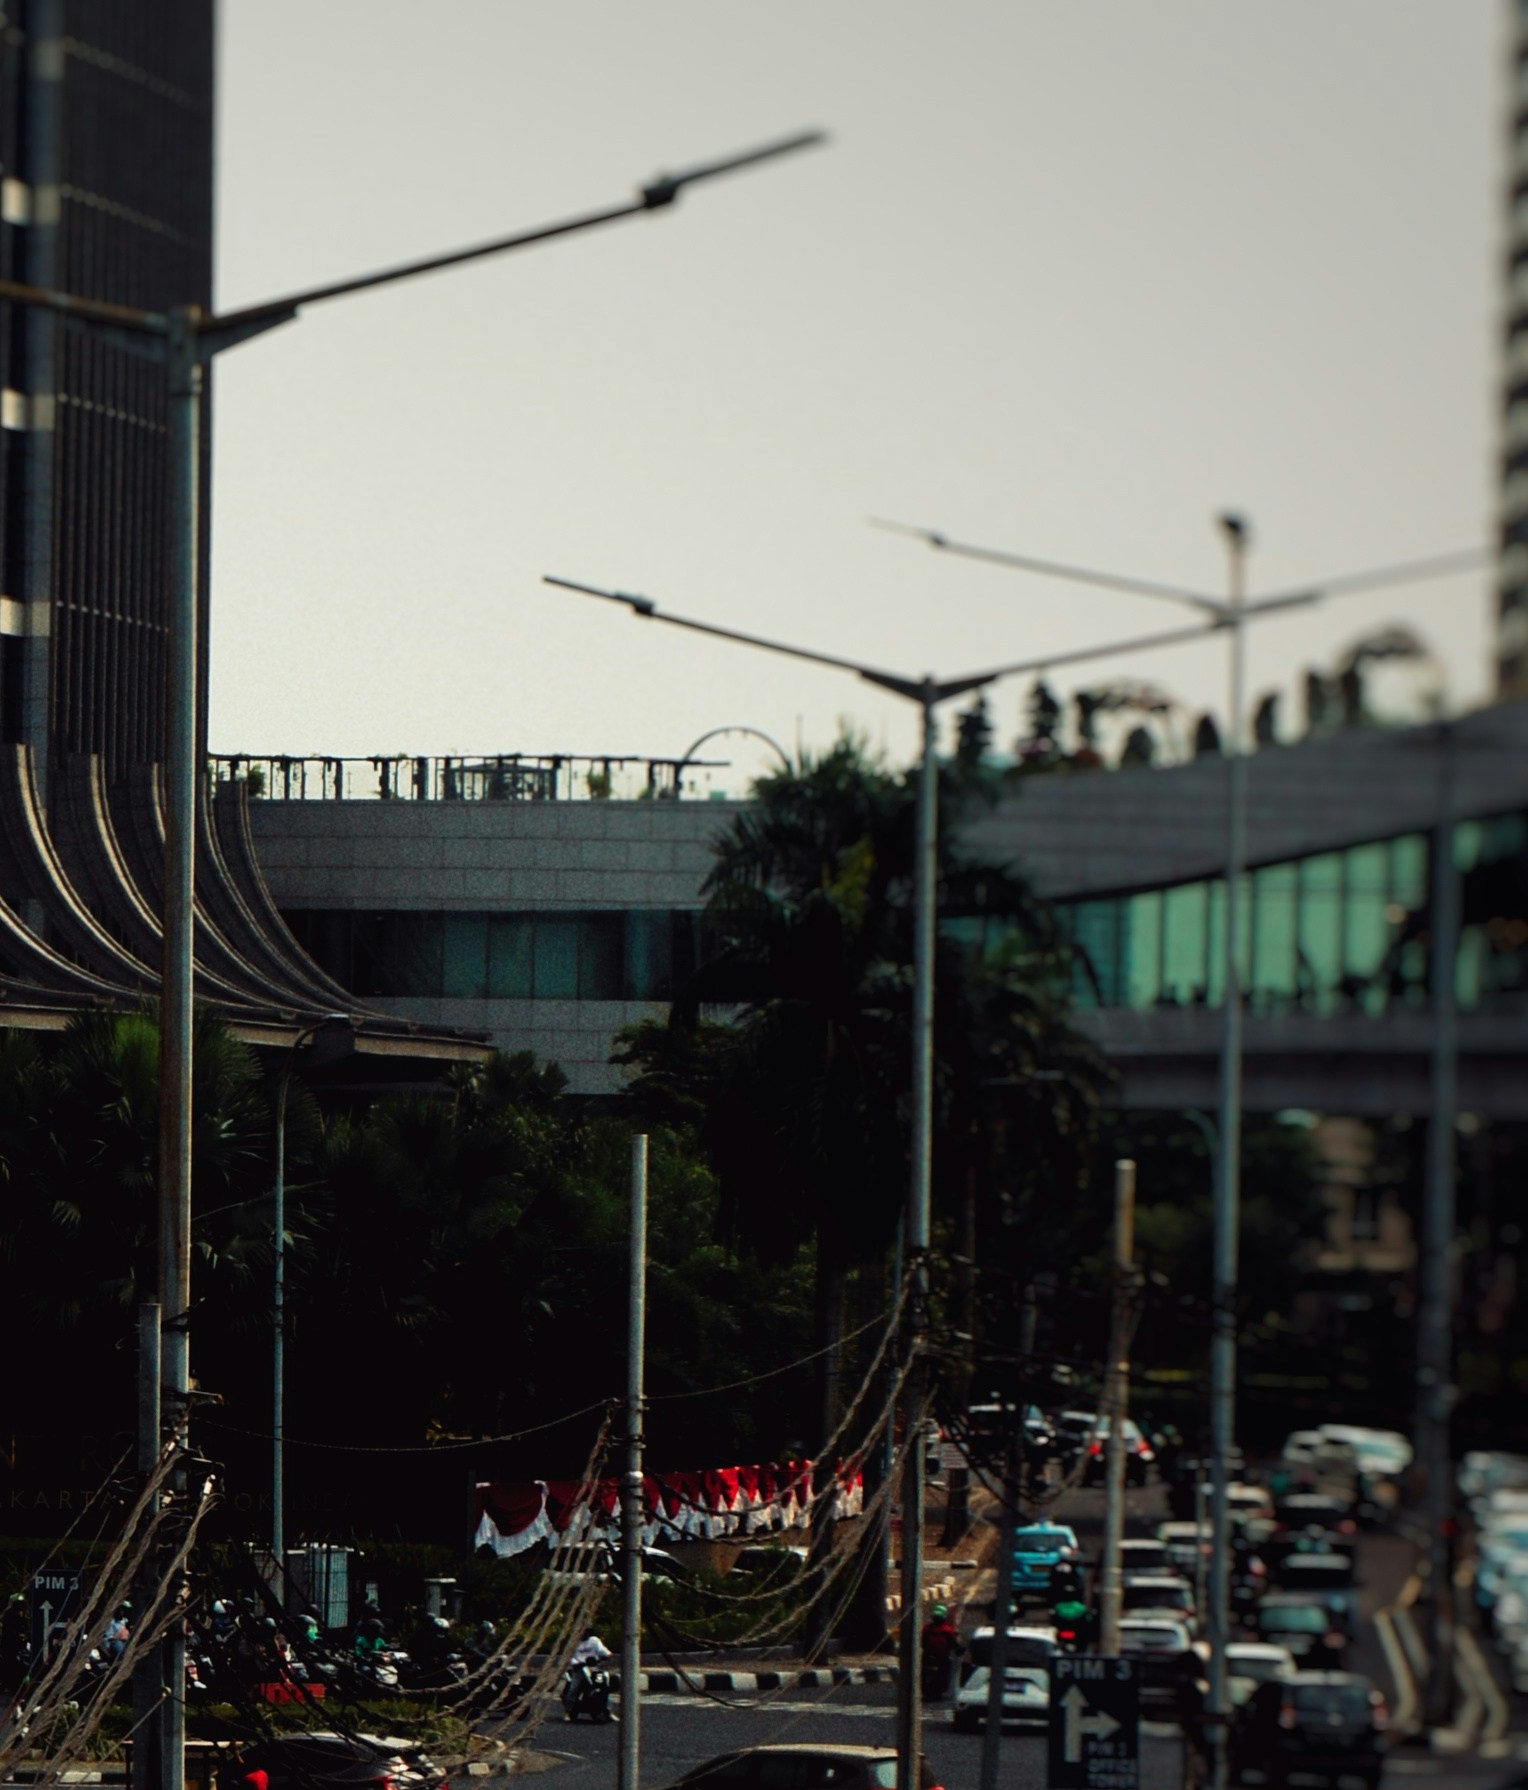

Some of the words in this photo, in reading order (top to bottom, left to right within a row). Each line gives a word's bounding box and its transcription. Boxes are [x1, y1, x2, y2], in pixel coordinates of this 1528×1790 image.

[34, 1576, 65, 1589] PIM
[1055, 1659, 1106, 1680] PIM
[1114, 1659, 1133, 1681] 3
